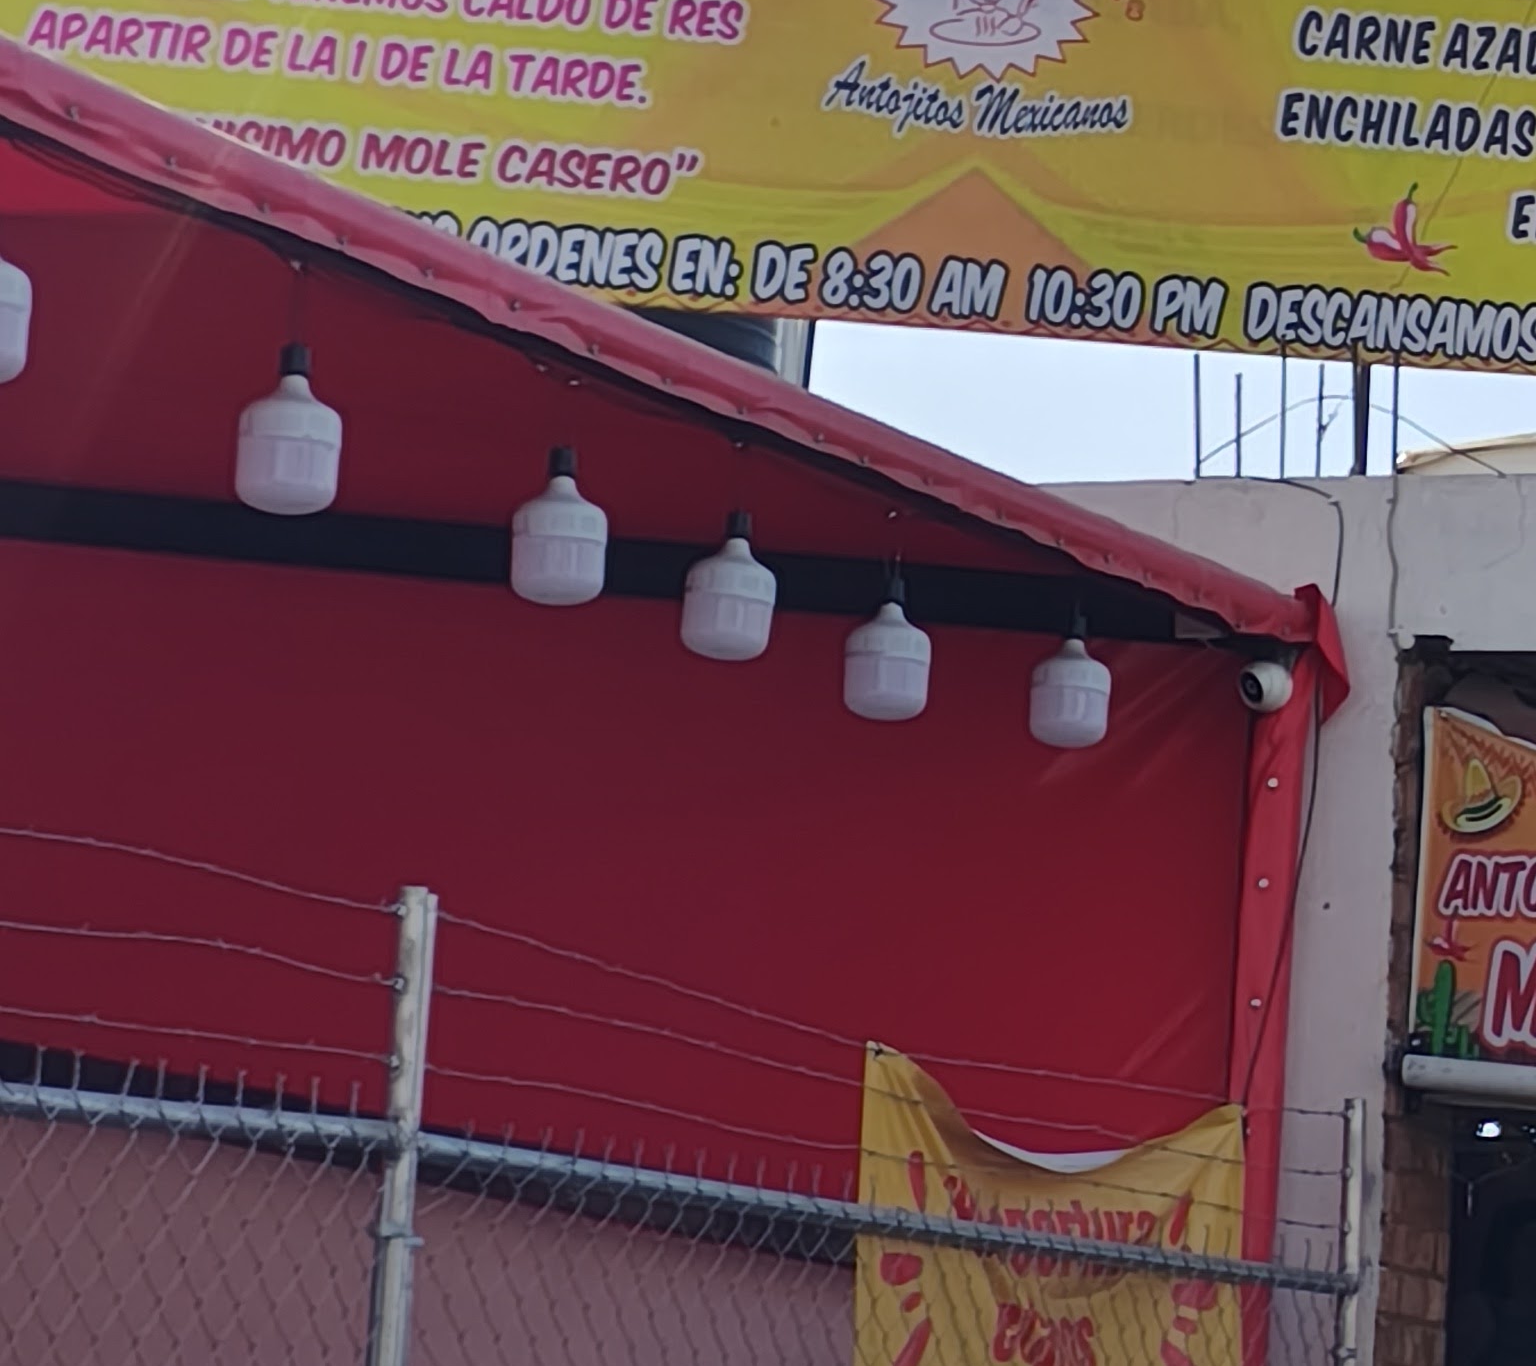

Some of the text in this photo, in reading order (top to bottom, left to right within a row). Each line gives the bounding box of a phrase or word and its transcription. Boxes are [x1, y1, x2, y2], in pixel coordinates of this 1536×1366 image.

[28, 9, 211, 63] APARTIR
[222, 28, 279, 68] DE
[287, 34, 338, 76] LA
[380, 42, 434, 82] DE
[444, 48, 494, 89] LA
[509, 53, 647, 104] TARDE.
[1298, 10, 1436, 65] CARNE
[825, 60, 1129, 135] Antojitos Mexicanos
[361, 135, 486, 178] MOLE
[669, 233, 743, 300] EN:
[751, 241, 819, 303] DE
[820, 246, 923, 313] 8:30
[928, 254, 1008, 321] AM
[1026, 265, 1145, 332] 10:30
[1151, 274, 1228, 339] PM
